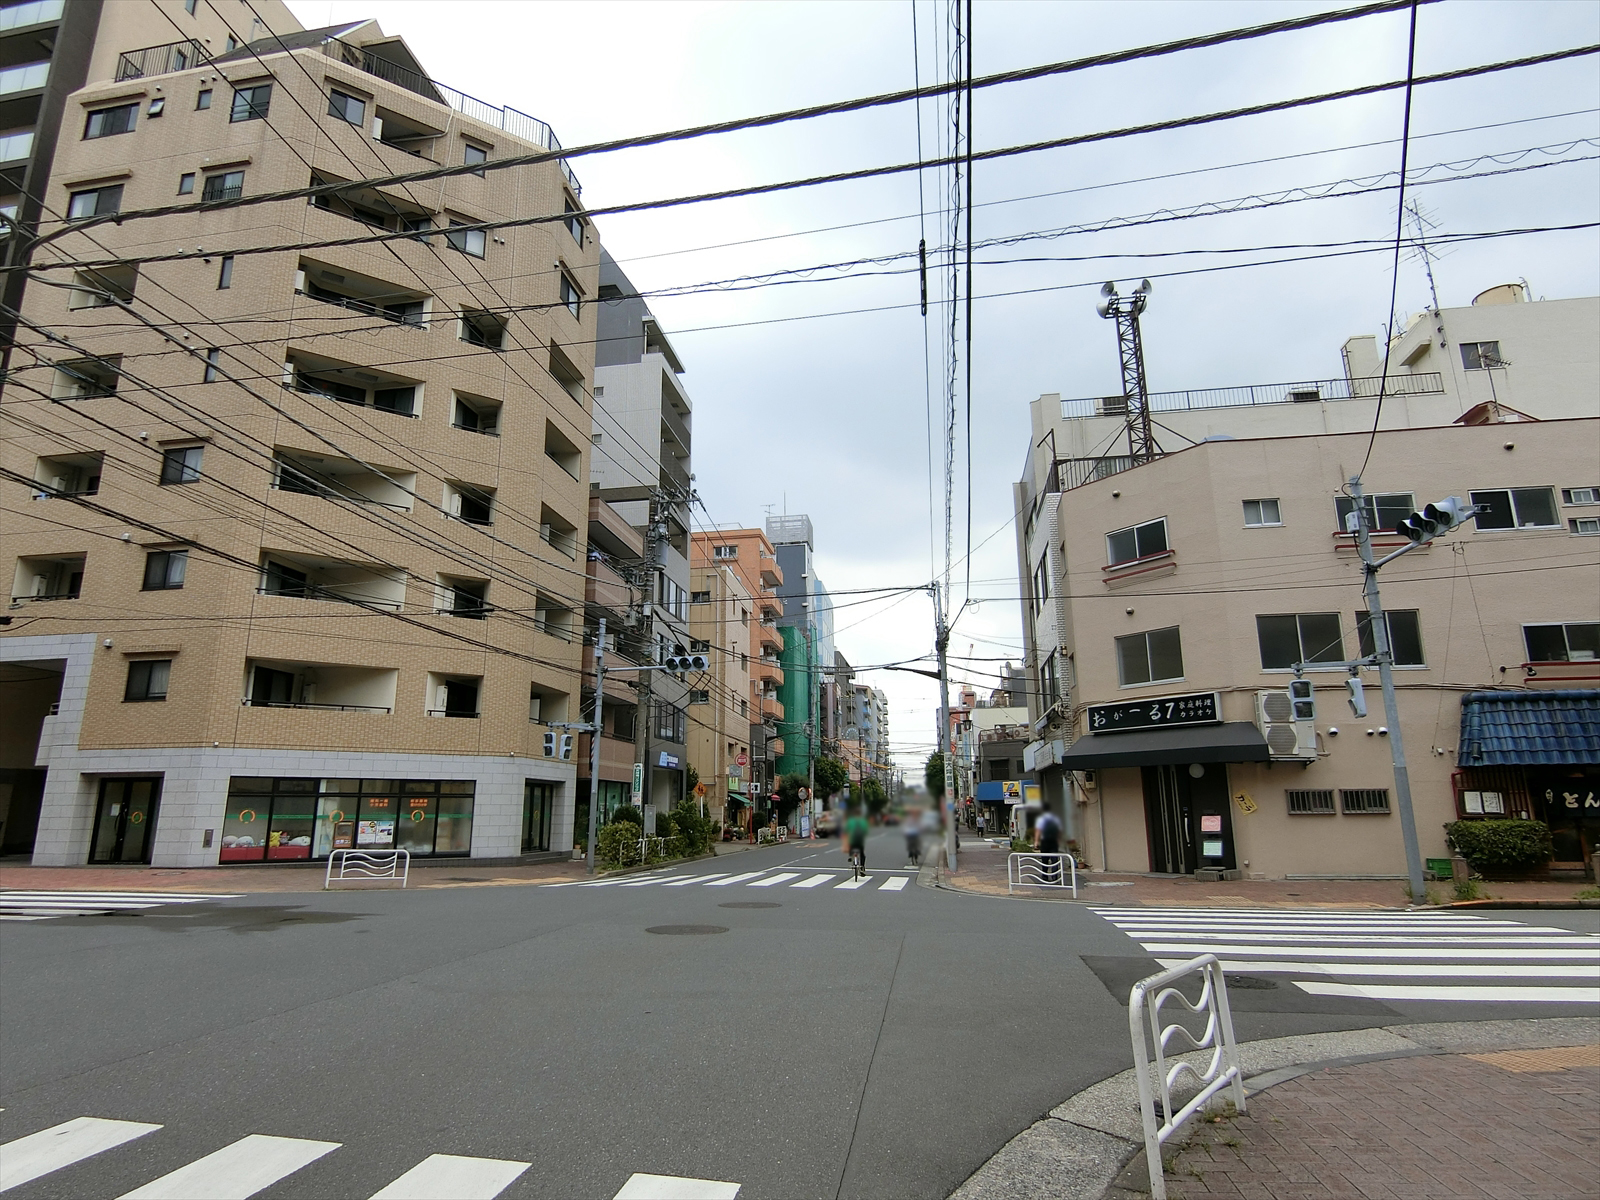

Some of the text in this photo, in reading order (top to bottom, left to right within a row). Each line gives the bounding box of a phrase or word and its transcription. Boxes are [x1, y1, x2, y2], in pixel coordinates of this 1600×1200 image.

[1178, 698, 1212, 709] 家庭料理
[1179, 708, 1212, 718] カラオケ
